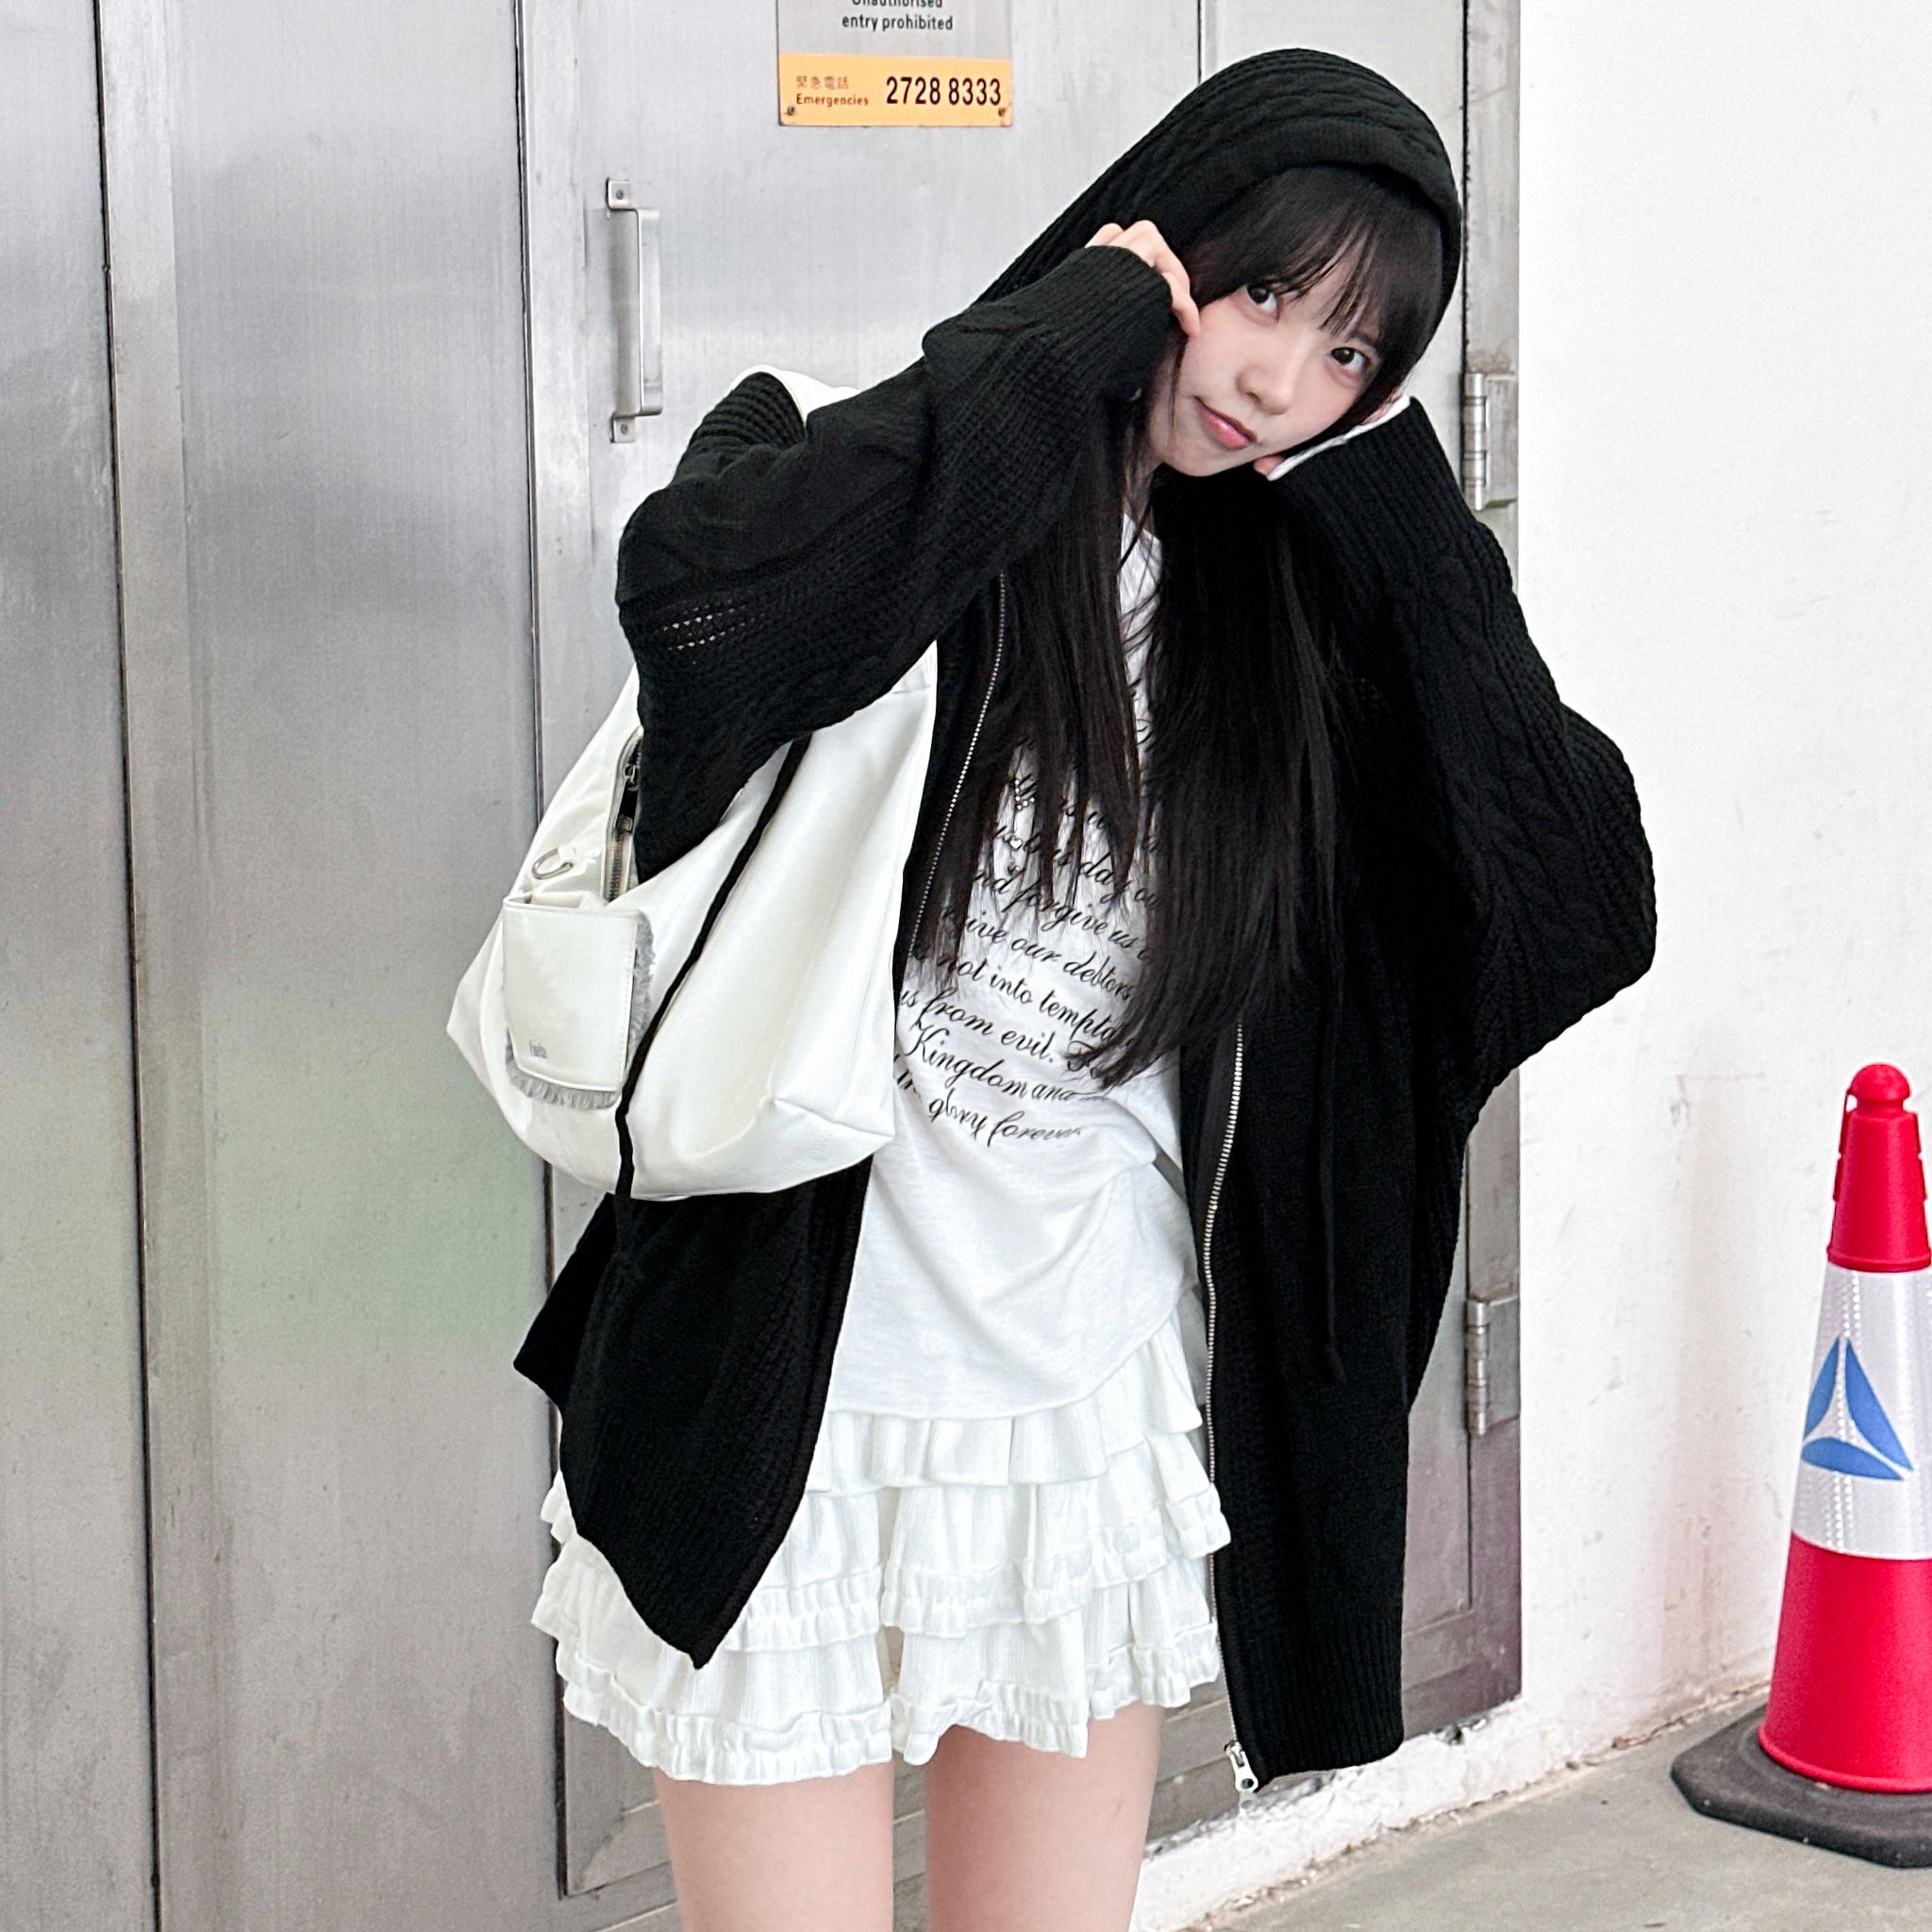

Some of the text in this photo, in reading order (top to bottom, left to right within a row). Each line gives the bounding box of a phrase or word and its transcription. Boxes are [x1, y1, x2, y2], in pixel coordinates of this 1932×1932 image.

[841, 13, 953, 32] entry prohibited
[795, 75, 849, 91] 緊急電話
[886, 75, 1002, 107] 2728 8333
[795, 92, 869, 108] Emergencies
[1108, 929, 1139, 949] us
[990, 965, 1034, 1005] into
[1010, 938, 1063, 963] our
[1062, 950, 1135, 1002] debtors
[909, 987, 994, 1036] from
[1000, 1029, 1055, 1063] evil.
[903, 1019, 1028, 1101] Kingdom
